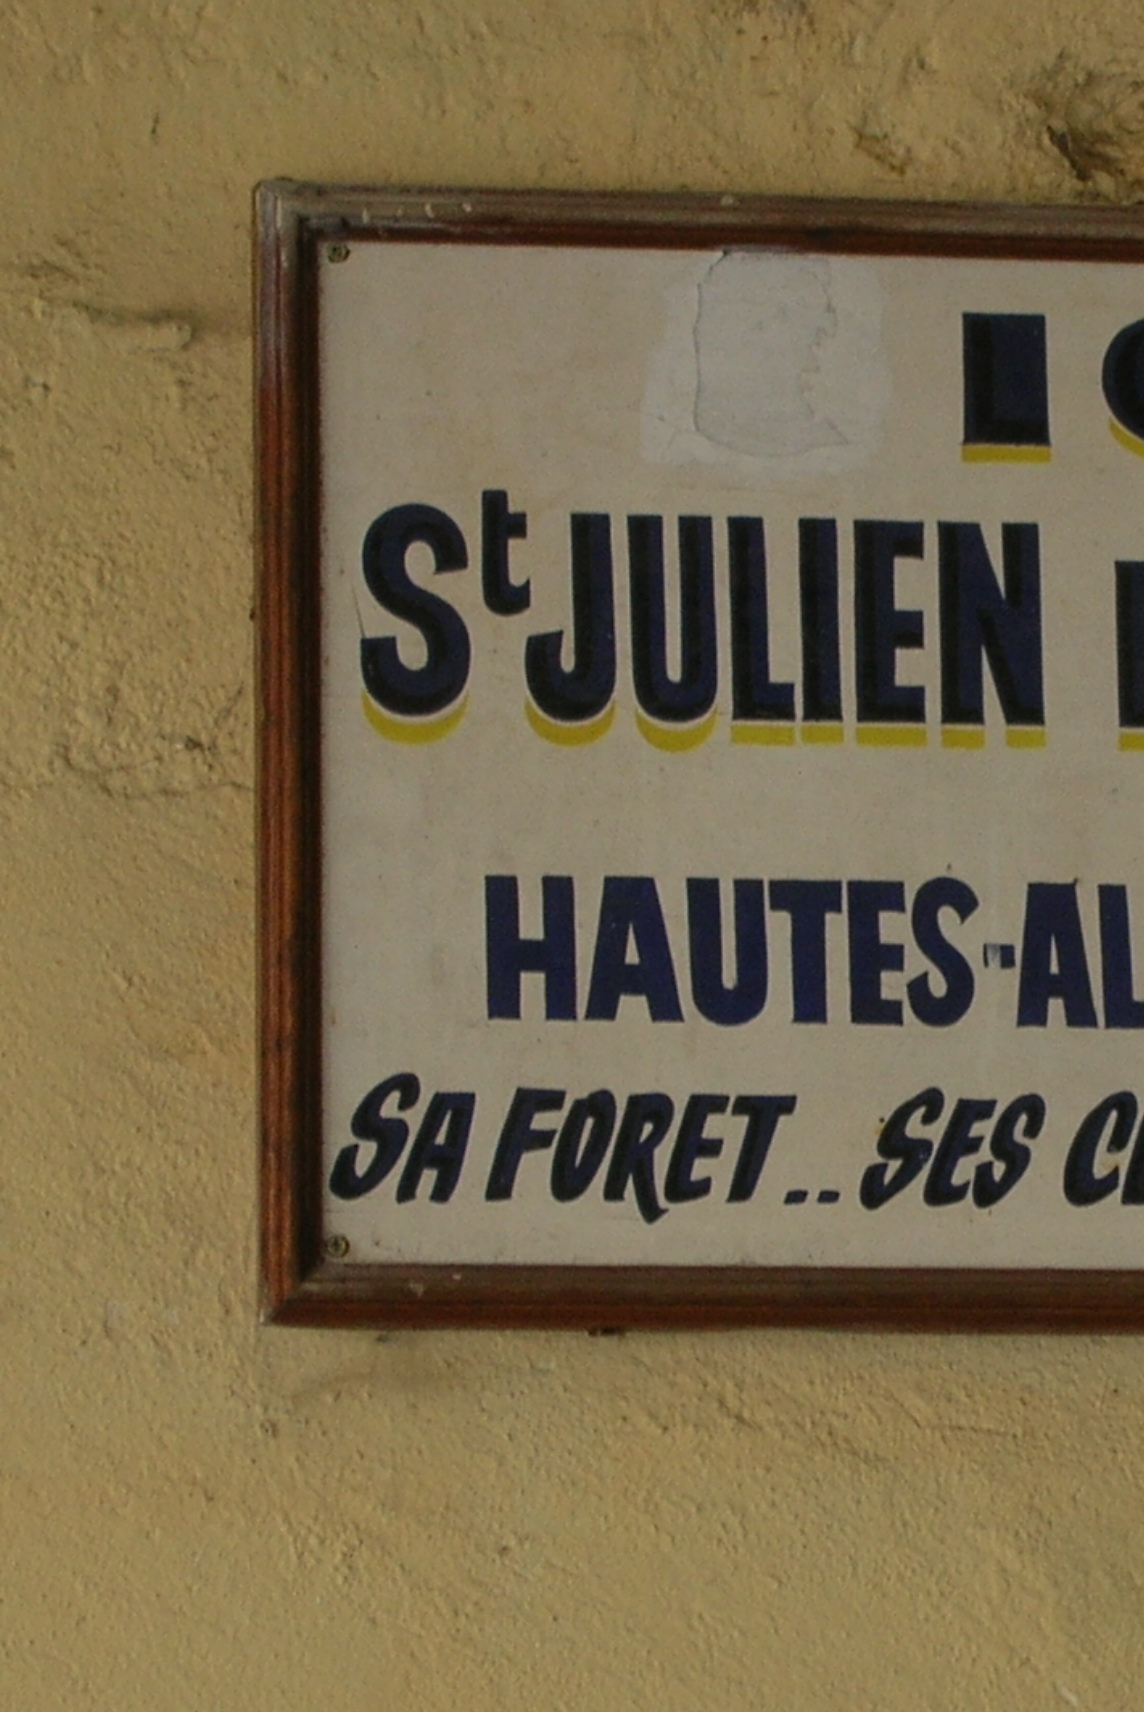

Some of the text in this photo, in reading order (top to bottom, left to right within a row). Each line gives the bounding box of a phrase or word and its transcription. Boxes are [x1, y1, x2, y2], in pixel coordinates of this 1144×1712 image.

[361, 490, 530, 718] St
[525, 513, 1044, 726] JULIEN
[329, 1073, 475, 1204] SA
[860, 1088, 1045, 1210] SES
